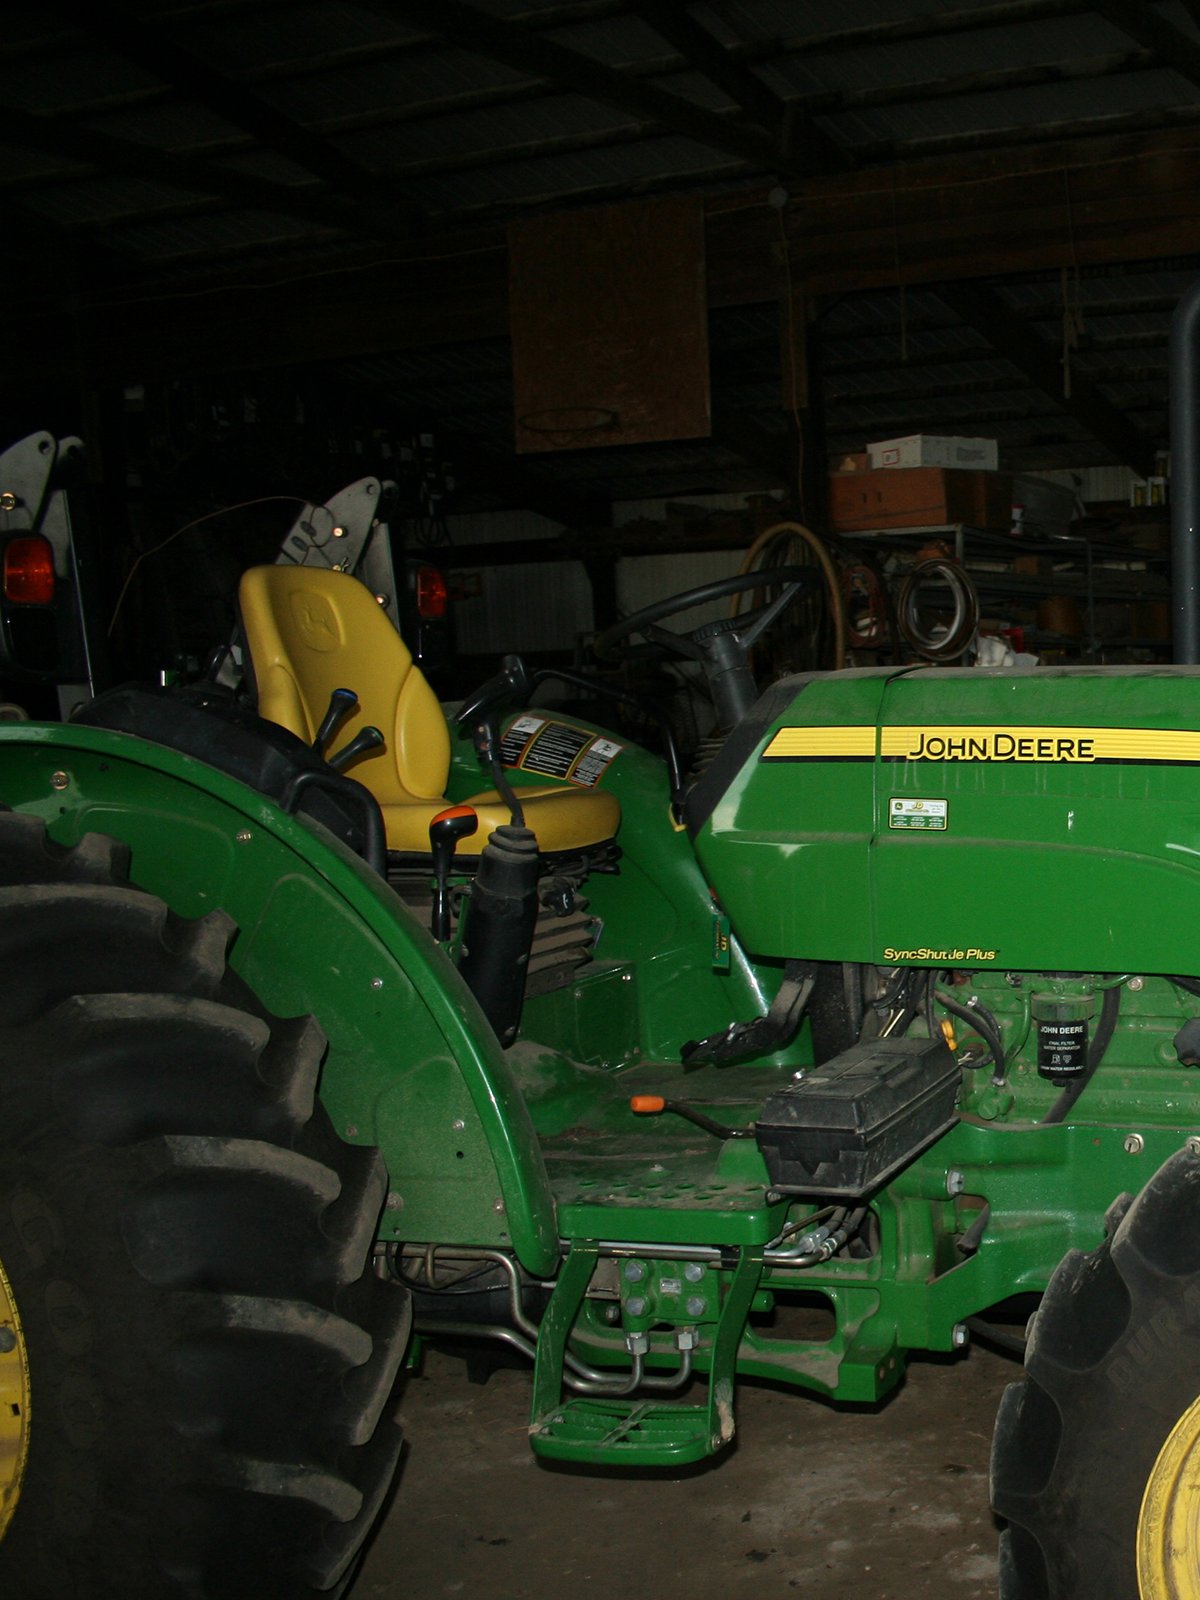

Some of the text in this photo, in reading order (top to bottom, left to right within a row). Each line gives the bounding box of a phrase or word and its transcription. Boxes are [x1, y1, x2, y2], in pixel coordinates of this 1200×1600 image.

[909, 733, 1095, 759] JOHN DEERE
[966, 948, 996, 960] Plus
[1041, 1026, 1083, 1034] JOHN DEERE
